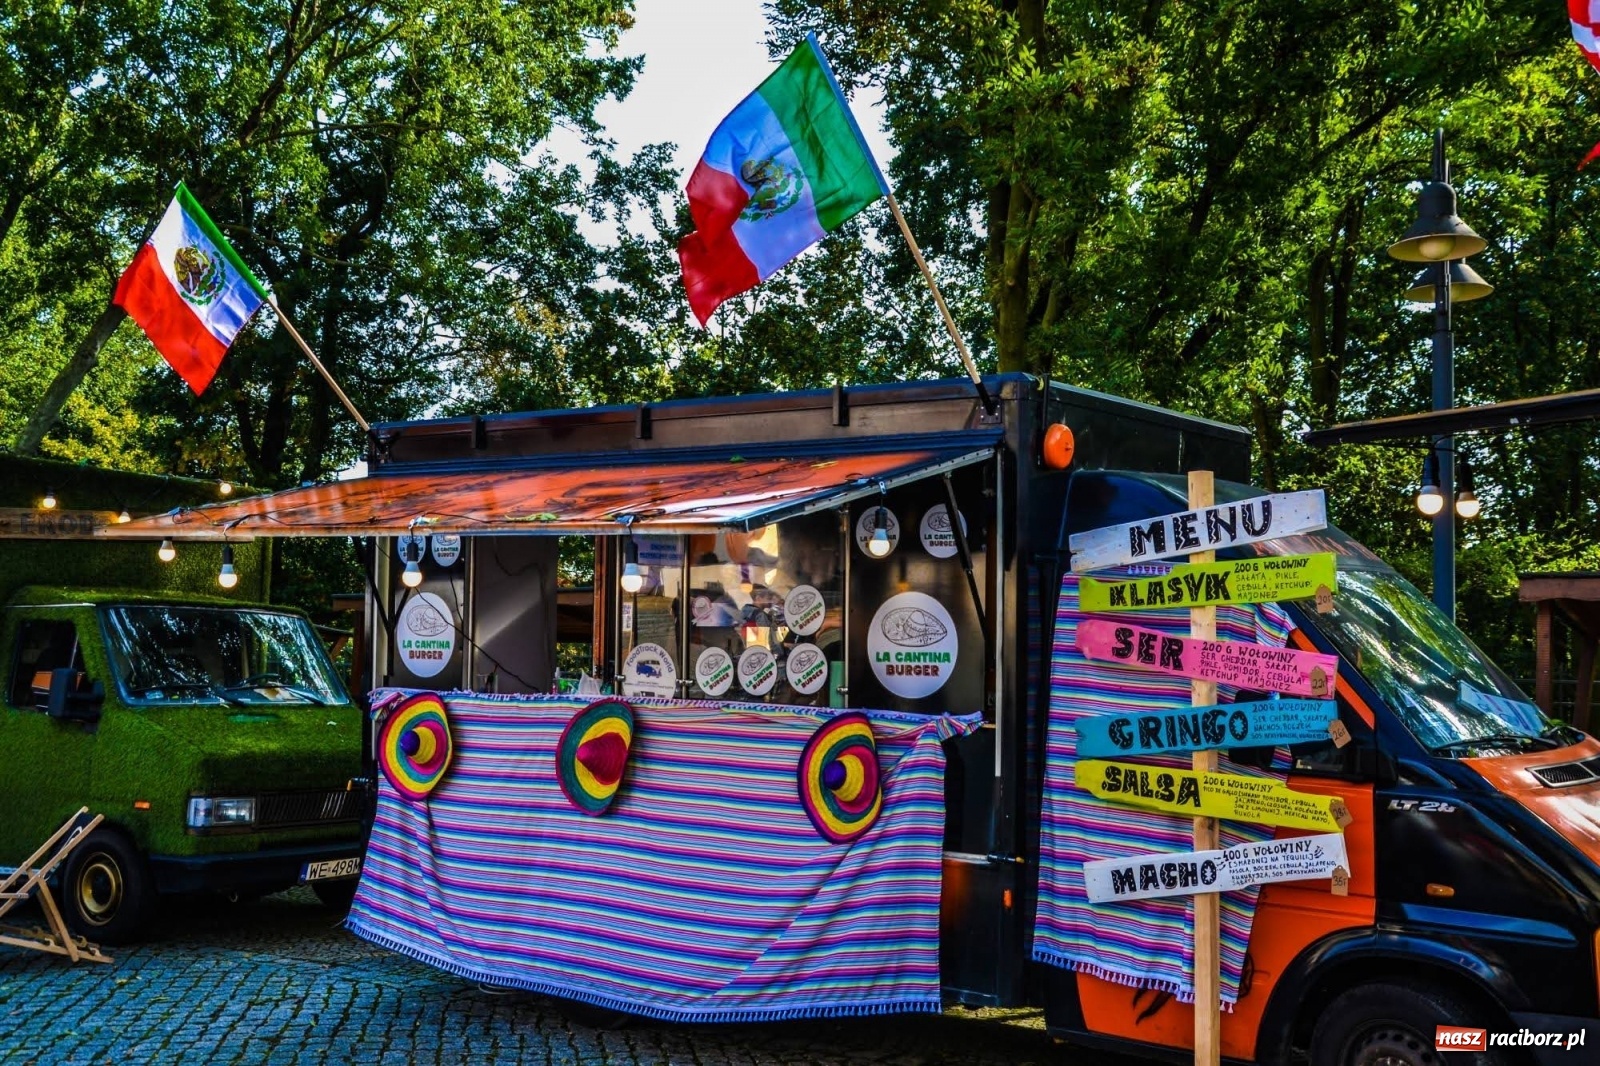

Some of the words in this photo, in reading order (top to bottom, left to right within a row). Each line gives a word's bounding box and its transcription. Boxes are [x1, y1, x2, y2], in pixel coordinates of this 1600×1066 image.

[1130, 500, 1272, 557] MENU
[1234, 562, 1251, 573] 200
[1264, 558, 1310, 570] WOŁOWINY
[1238, 590, 1278, 601] MAJONEZ
[792, 620, 800, 628] LA
[800, 602, 822, 621] CANTINA
[798, 610, 820, 630] BURGER
[402, 640, 412, 648] LA
[414, 640, 450, 650] CANTINA
[1111, 627, 1184, 671] SER
[1202, 641, 1222, 653] 200
[1226, 646, 1232, 654] G
[1238, 646, 1296, 664] WOŁOWINY
[408, 650, 444, 660] BURGER
[658, 650, 674, 672] World
[876, 651, 890, 662] LA
[895, 652, 951, 663] CANTINA
[1200, 652, 1216, 660] SER
[702, 680, 710, 688] LA
[710, 664, 732, 680] CANTINA
[746, 680, 752, 688] LA
[753, 662, 775, 680] CANTINA
[794, 678, 802, 686] LA
[802, 660, 826, 680] CANTINA
[801, 669, 824, 688] BURGER
[886, 664, 940, 676] BURGER
[709, 672, 730, 690] BURGER
[752, 670, 773, 690] BURGER
[1247, 676, 1291, 691] MAJONEZ
[1278, 702, 1323, 712] WOŁOWINY
[1108, 709, 1248, 750] GRINGO
[1102, 766, 1201, 808] SALSA
[1227, 780, 1274, 792] WOŁOWINY
[1388, 800, 1418, 810] LT
[1253, 840, 1312, 856] WOŁOWINY
[310, 862, 328, 878] WE
[1111, 860, 1216, 894] MACHO
